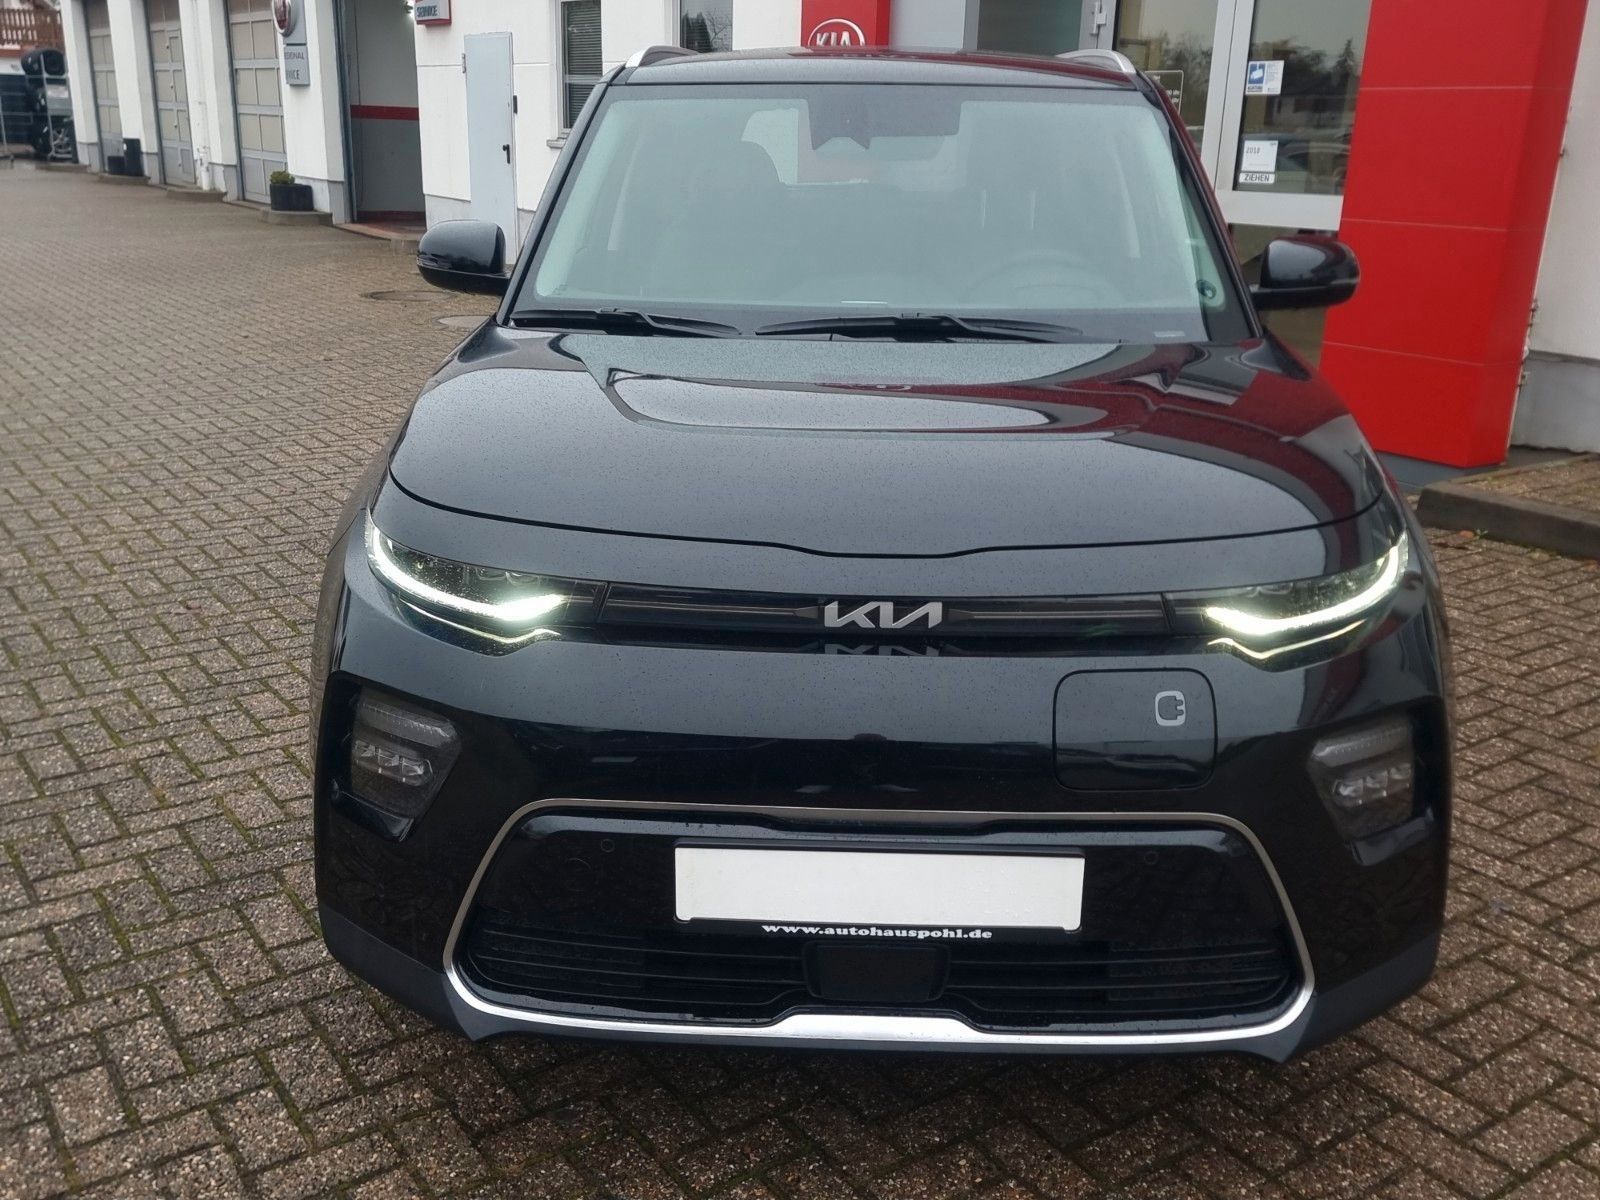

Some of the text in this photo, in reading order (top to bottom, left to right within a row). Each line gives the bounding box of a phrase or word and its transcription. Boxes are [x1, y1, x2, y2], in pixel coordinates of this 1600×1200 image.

[816, 31, 851, 47] KIA
[1244, 173, 1270, 182] ZIEHEN
[824, 601, 943, 629] KIA
[762, 925, 992, 939] www.autohauspohl.de
